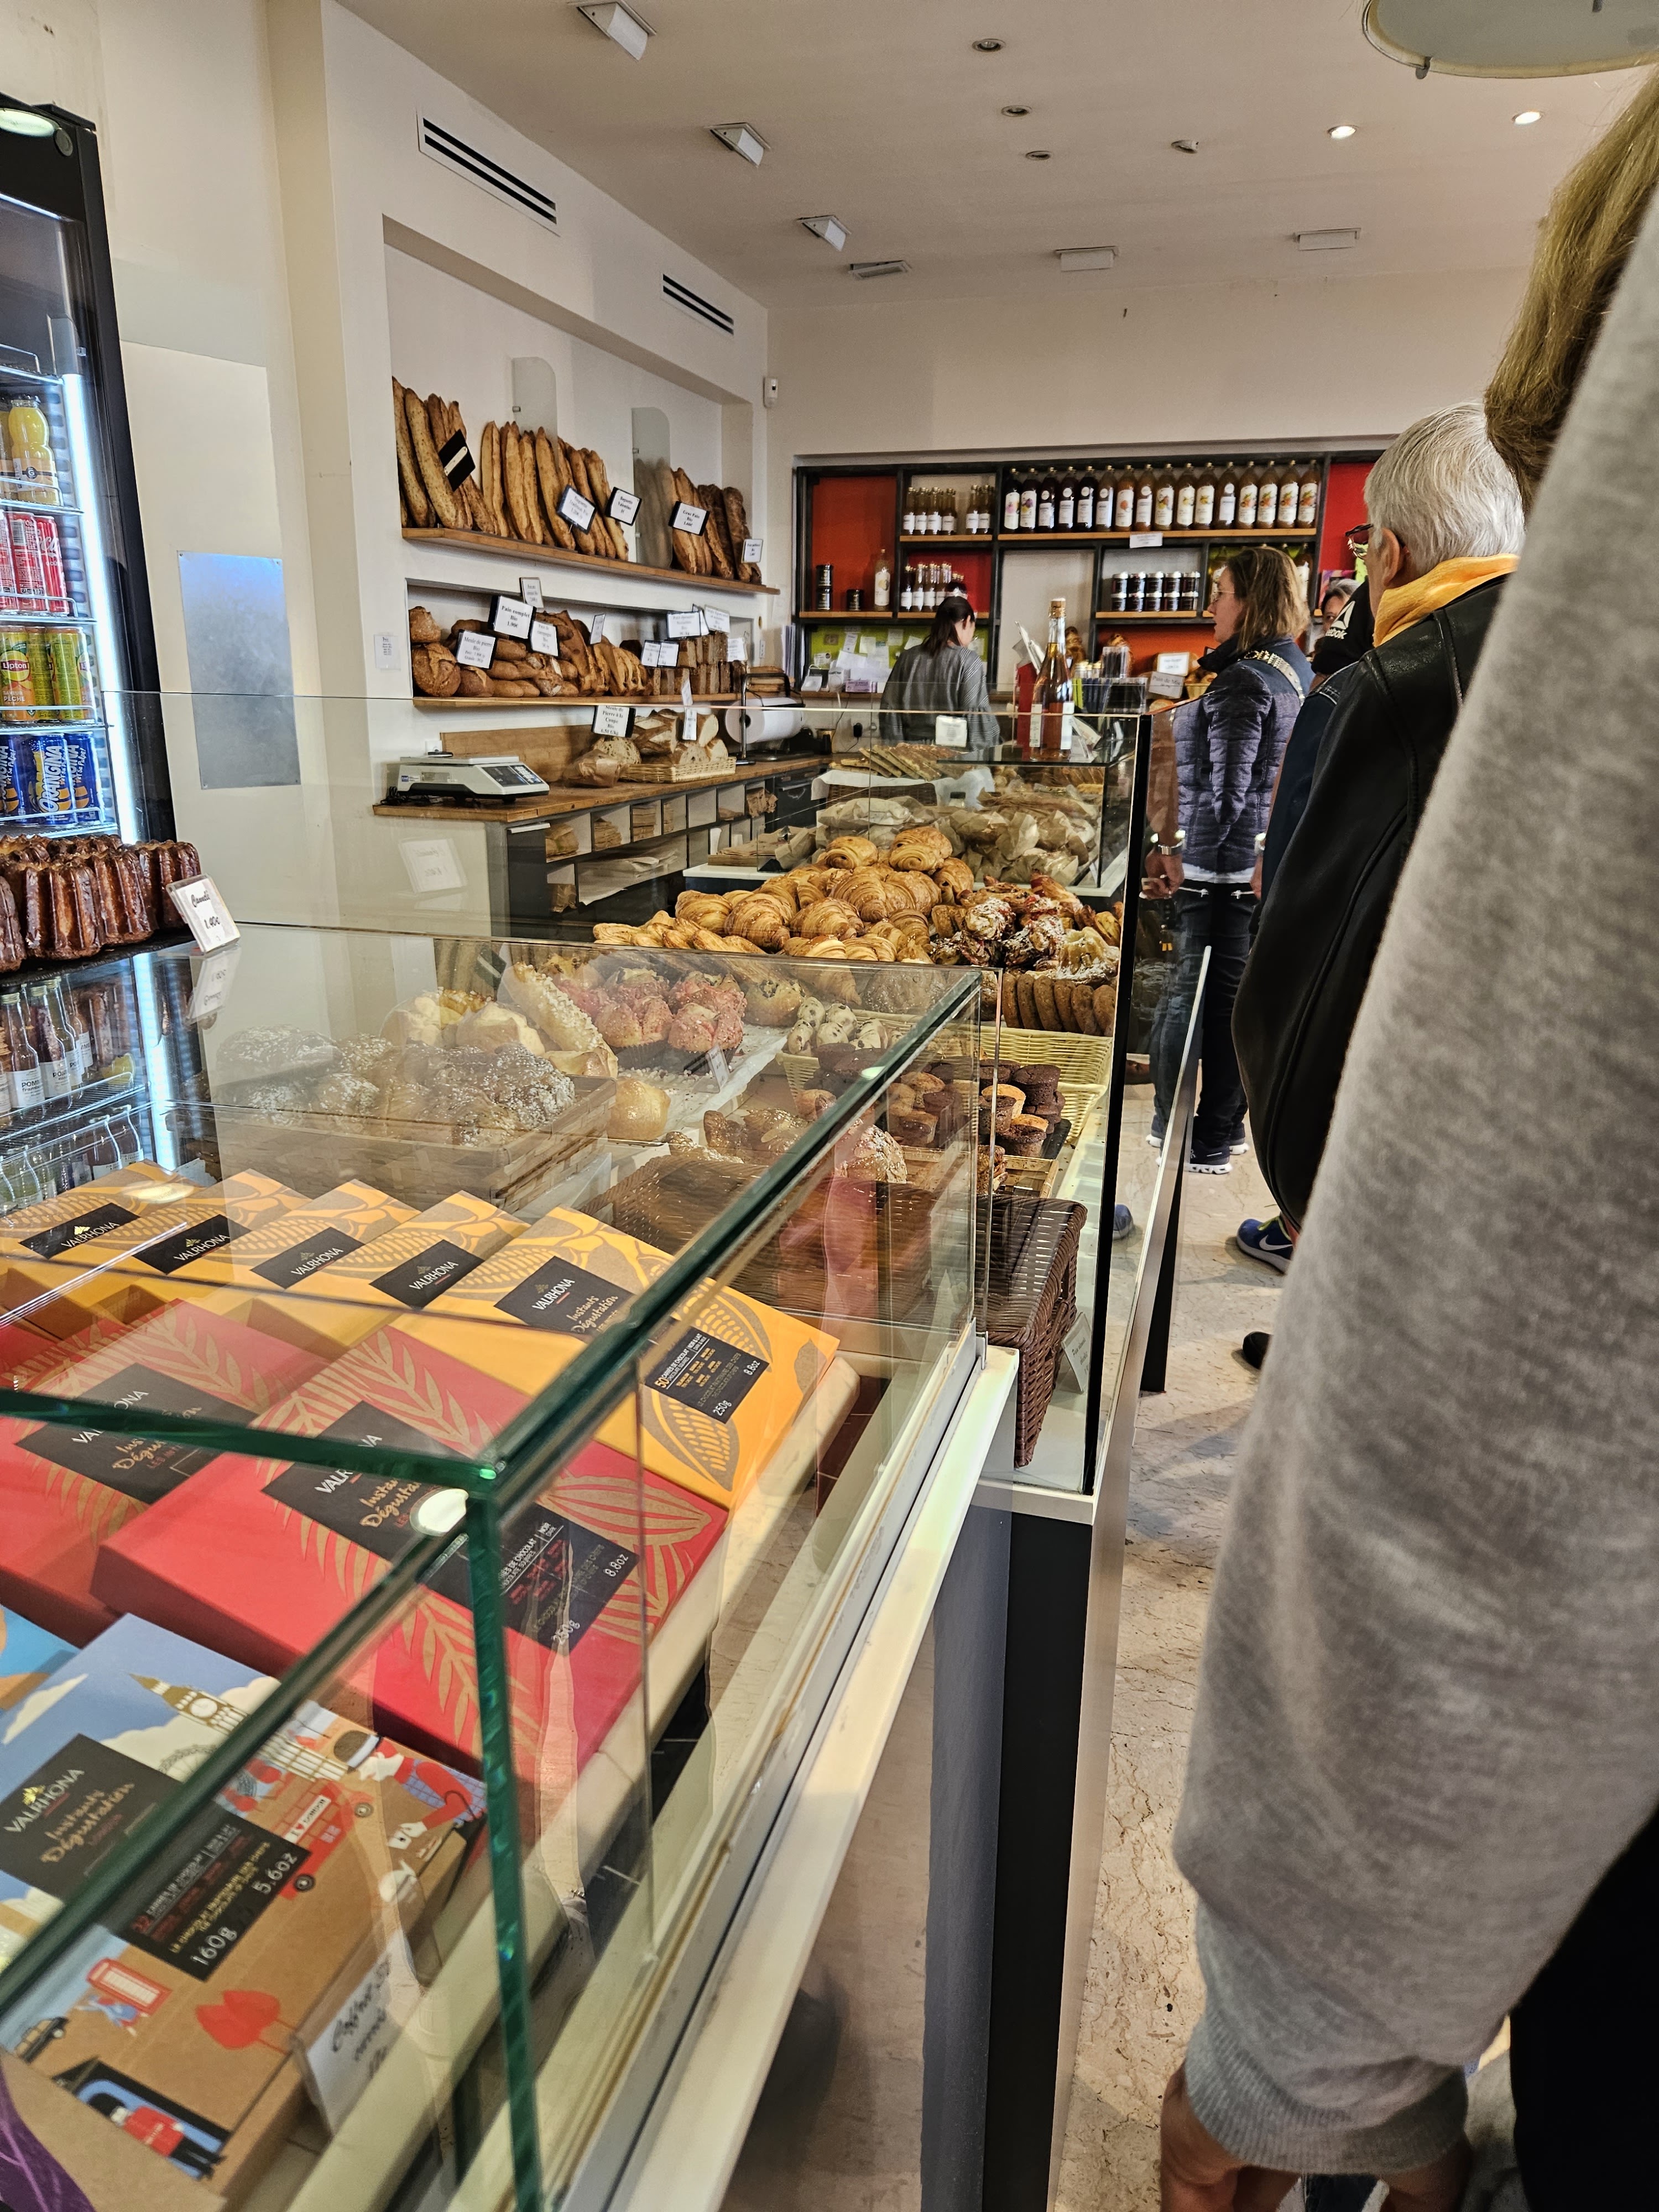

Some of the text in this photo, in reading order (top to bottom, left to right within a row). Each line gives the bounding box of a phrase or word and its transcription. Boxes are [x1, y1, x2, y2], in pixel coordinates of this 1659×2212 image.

[513, 609, 530, 618] complet
[1326, 628, 1348, 640] eebok
[61, 1220, 120, 1249] VALRHONA
[173, 1233, 231, 1262] VALRHONA
[290, 1246, 345, 1277] VALRHONA
[409, 1261, 459, 1291] VALRHONA
[531, 1277, 575, 1311] VALRHONA
[566, 1295, 599, 1322] Instants
[570, 1295, 619, 1334] Dégustation
[654, 1376, 670, 1388] 50
[674, 1348, 689, 1363] CHOCOLAT
[743, 1359, 760, 1375] 8.8oz
[712, 1399, 731, 1416] 250g
[538, 1521, 550, 1533] NOIR
[508, 1538, 536, 1569] DE CHOCOLAT
[603, 1552, 628, 1577] 8.8oz
[552, 1617, 580, 1647] 250g
[3, 1769, 85, 1832] VALRHONA
[44, 1789, 105, 1840] Instants
[252, 1850, 296, 1893] 5.6oz
[191, 1925, 237, 1966] 160g
